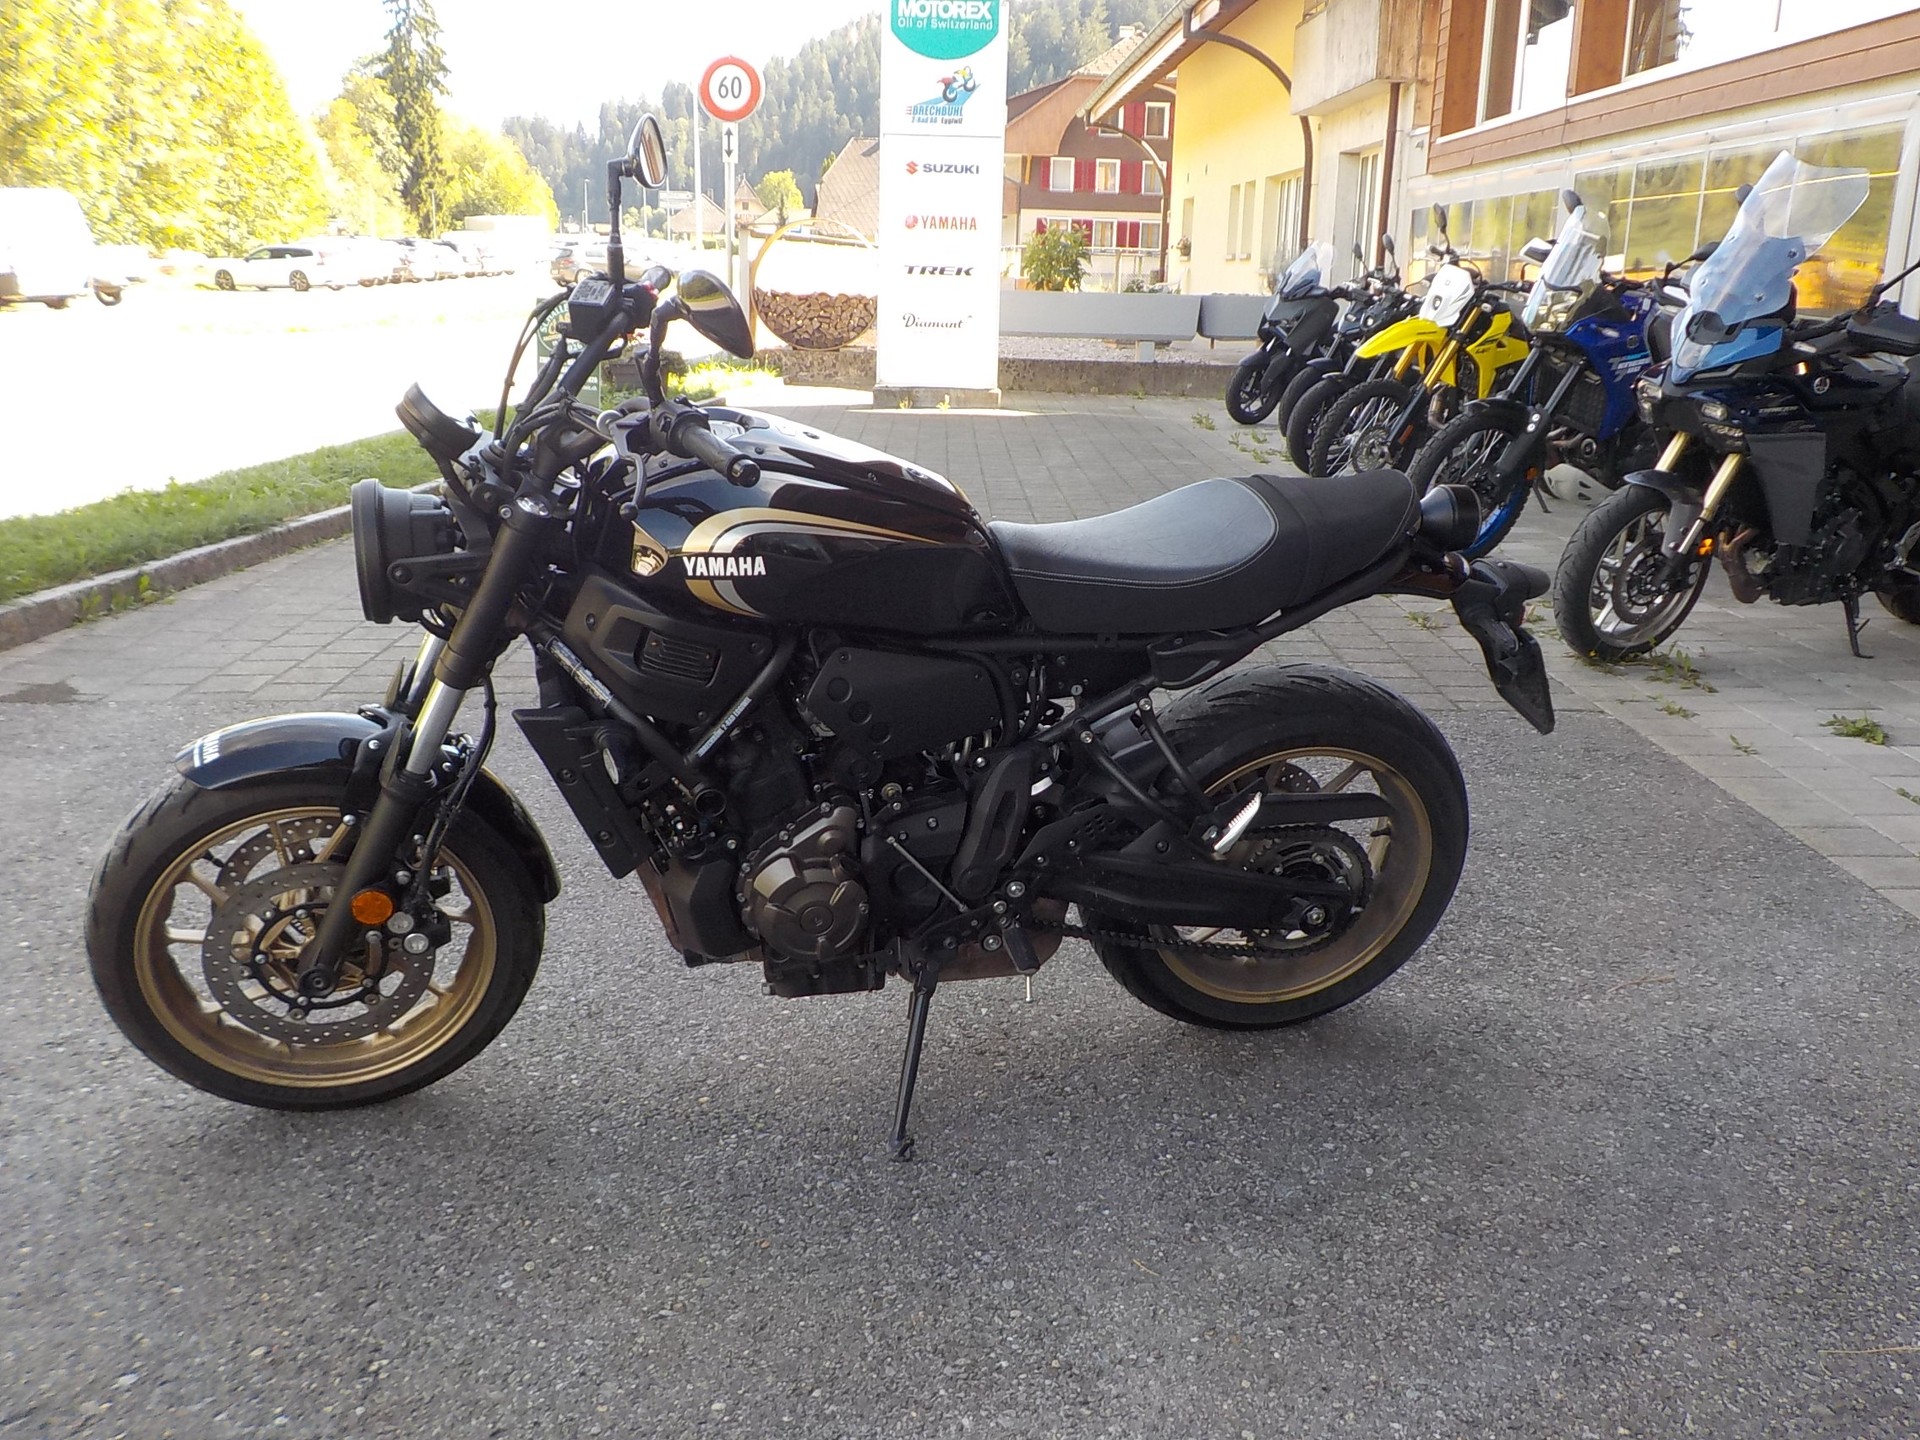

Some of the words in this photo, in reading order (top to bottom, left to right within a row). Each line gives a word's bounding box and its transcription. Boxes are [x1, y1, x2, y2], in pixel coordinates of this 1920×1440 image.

[897, 0, 993, 20] MOTOREX
[897, 17, 913, 28] Oil
[916, 18, 927, 29] of
[931, 18, 993, 30] Switzerland
[718, 76, 742, 99] 60
[923, 163, 980, 175] SUZUKI
[921, 215, 977, 231] YAMAHA
[904, 265, 974, 276] TREK
[902, 312, 964, 329] Diamant
[682, 556, 767, 576] YAMAHA
